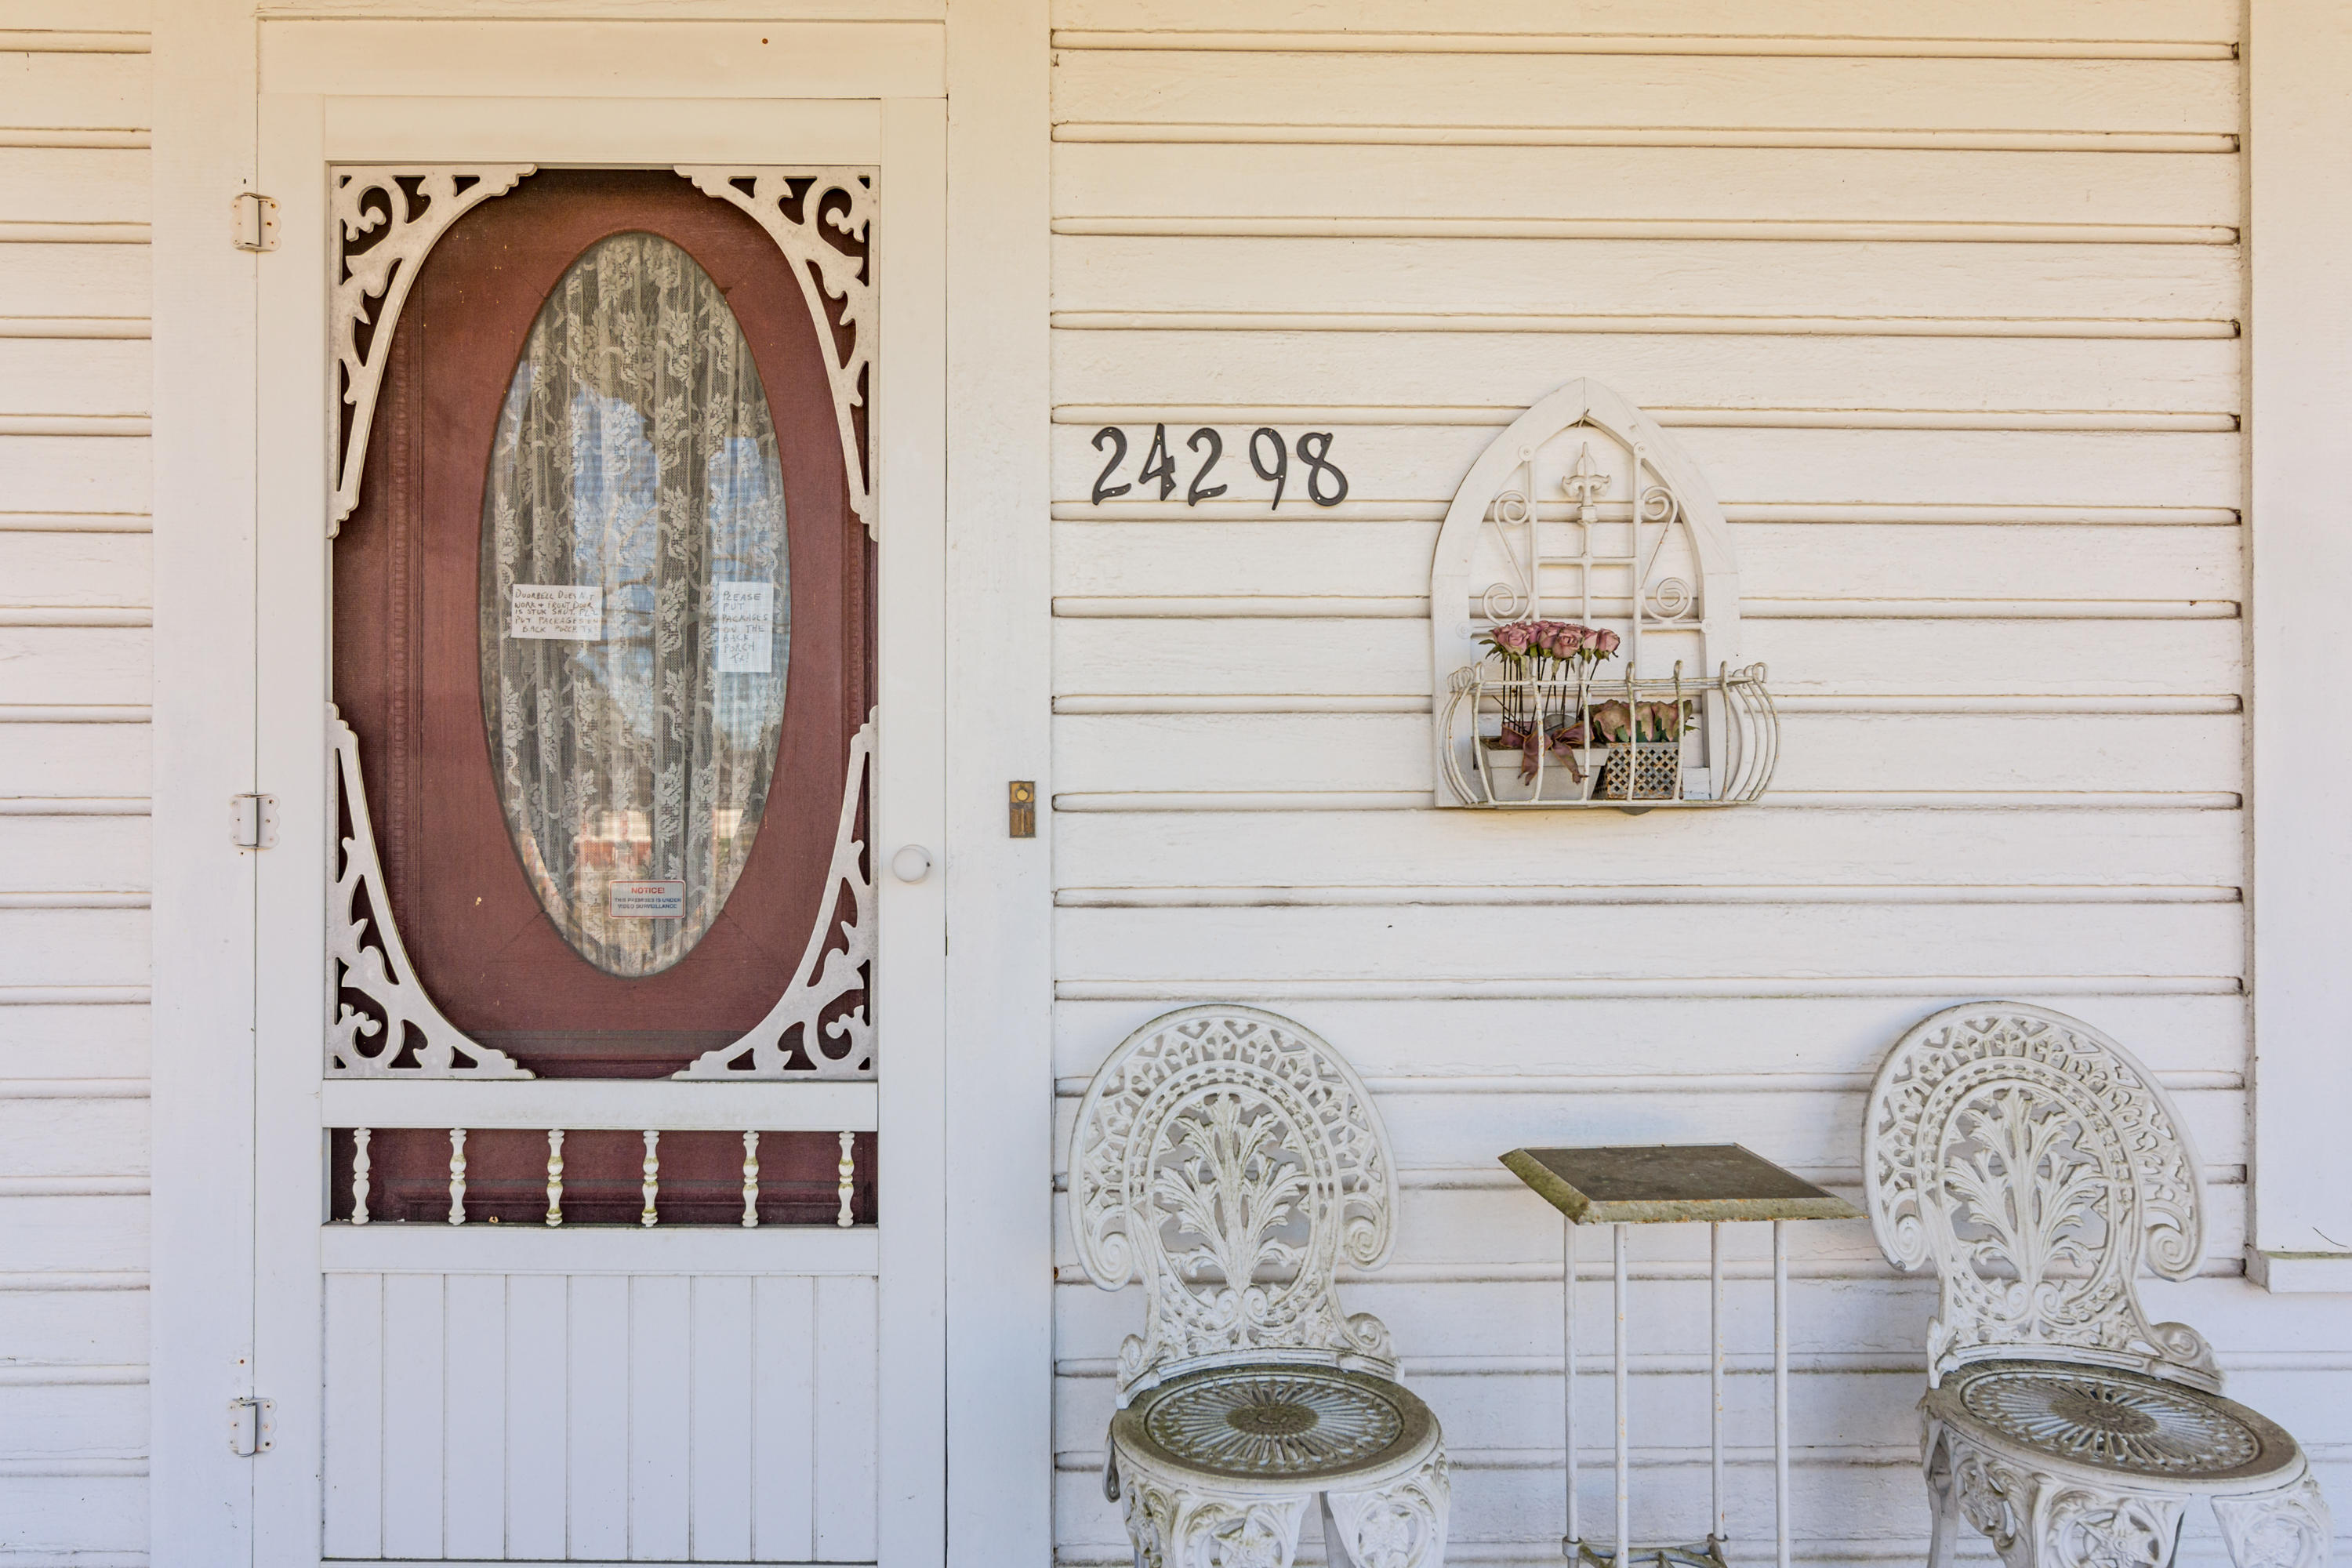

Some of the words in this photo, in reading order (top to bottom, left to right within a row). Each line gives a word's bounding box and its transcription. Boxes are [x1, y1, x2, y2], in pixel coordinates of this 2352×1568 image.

[1091, 423, 1348, 510] 24298
[723, 590, 760, 601] PLEASE
[722, 614, 768, 623] PACKAGES
[724, 633, 748, 642] BACK
[724, 641, 754, 653] PORCH
